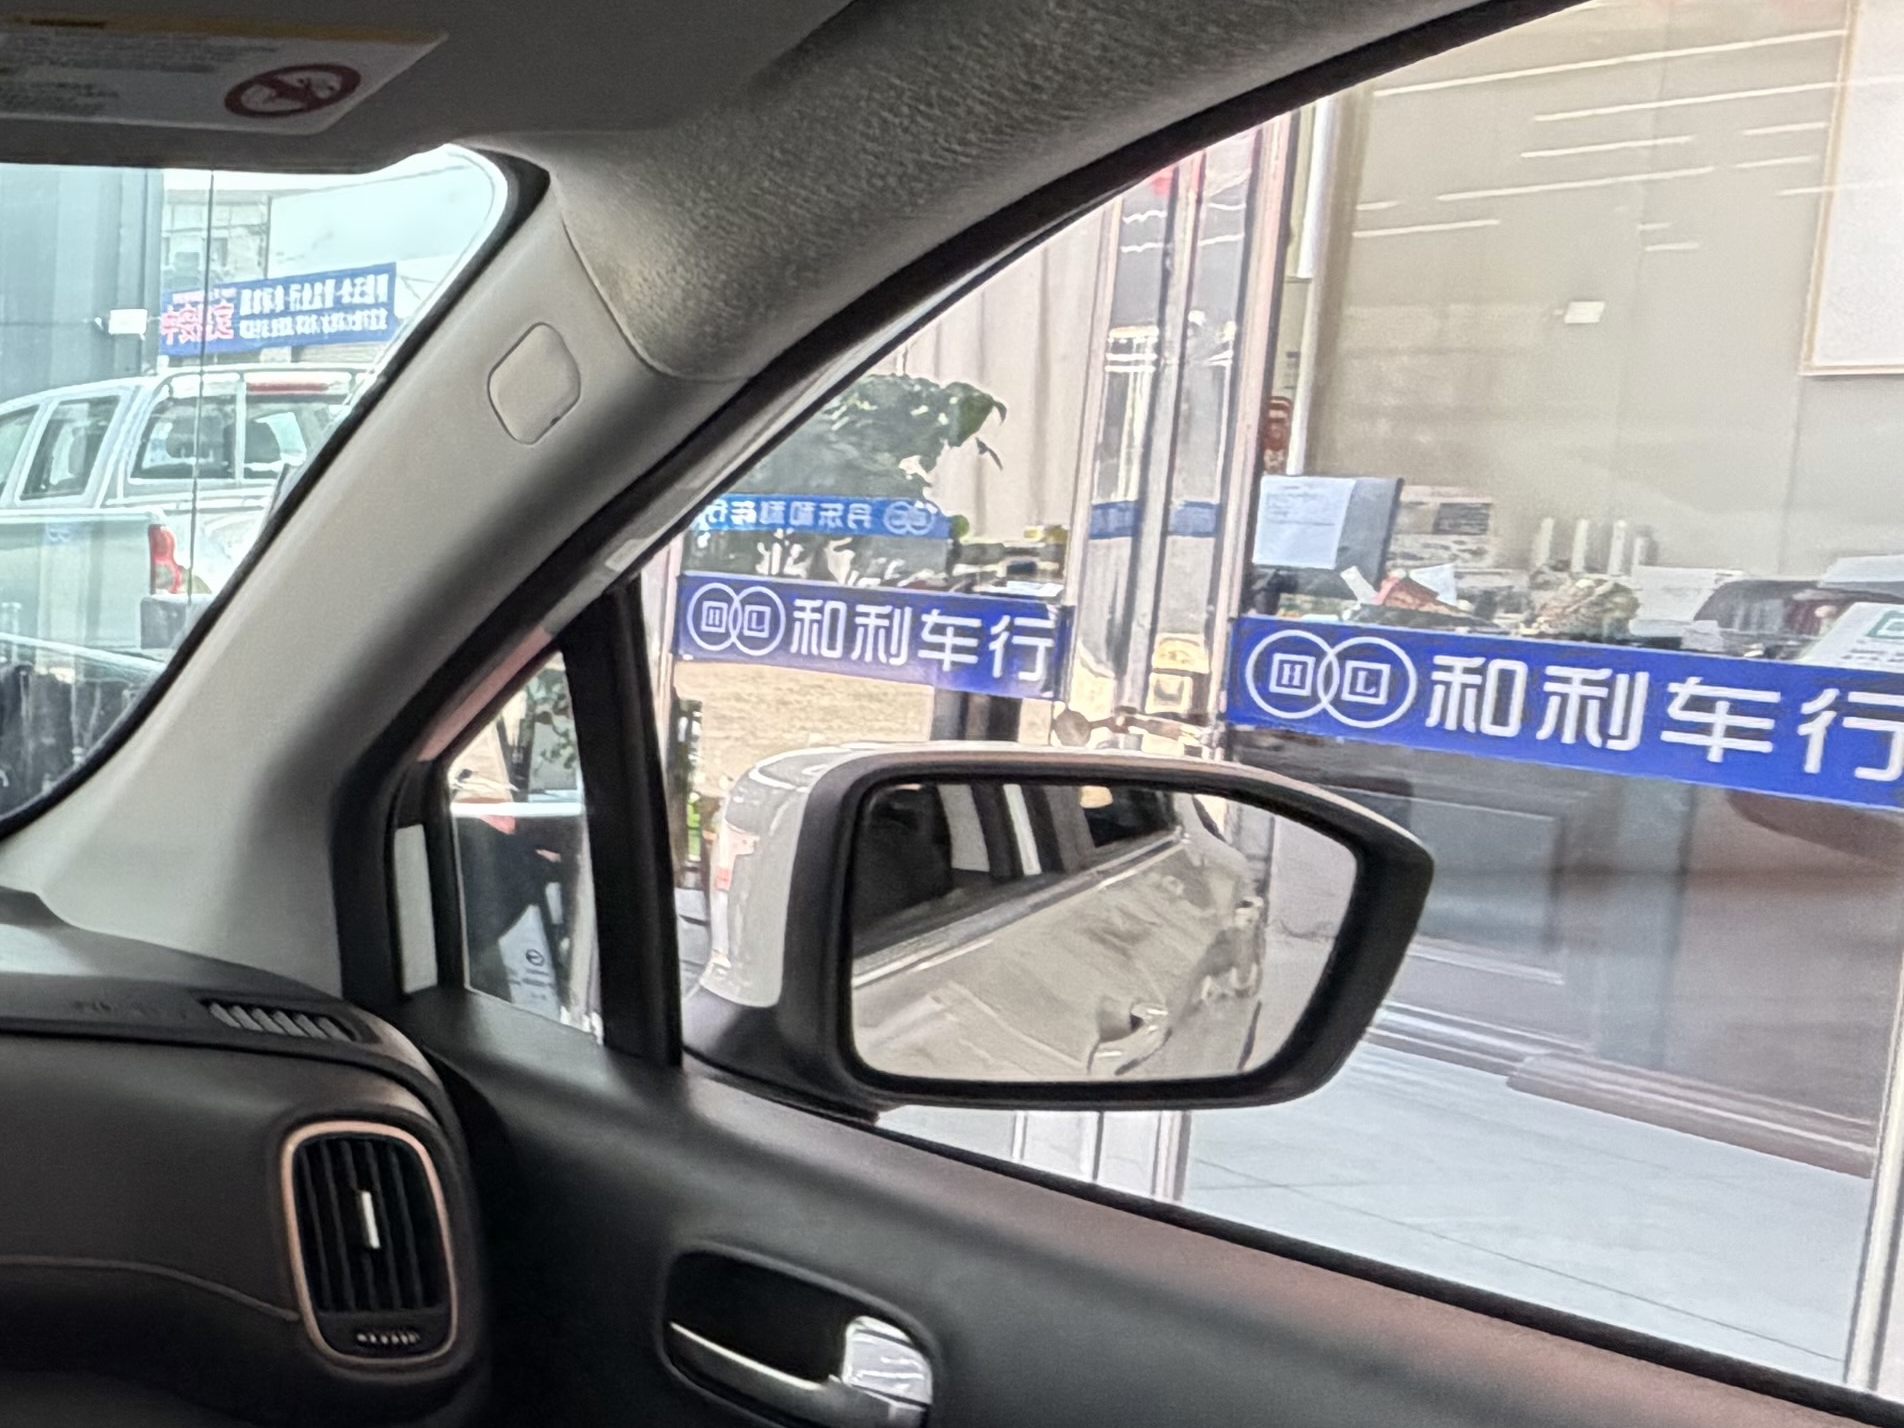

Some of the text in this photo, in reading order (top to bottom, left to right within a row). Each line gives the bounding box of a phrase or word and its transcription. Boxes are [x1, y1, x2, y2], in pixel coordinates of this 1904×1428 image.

[789, 597, 1056, 682] 和利车行
[1424, 653, 1904, 782] 和利车行
